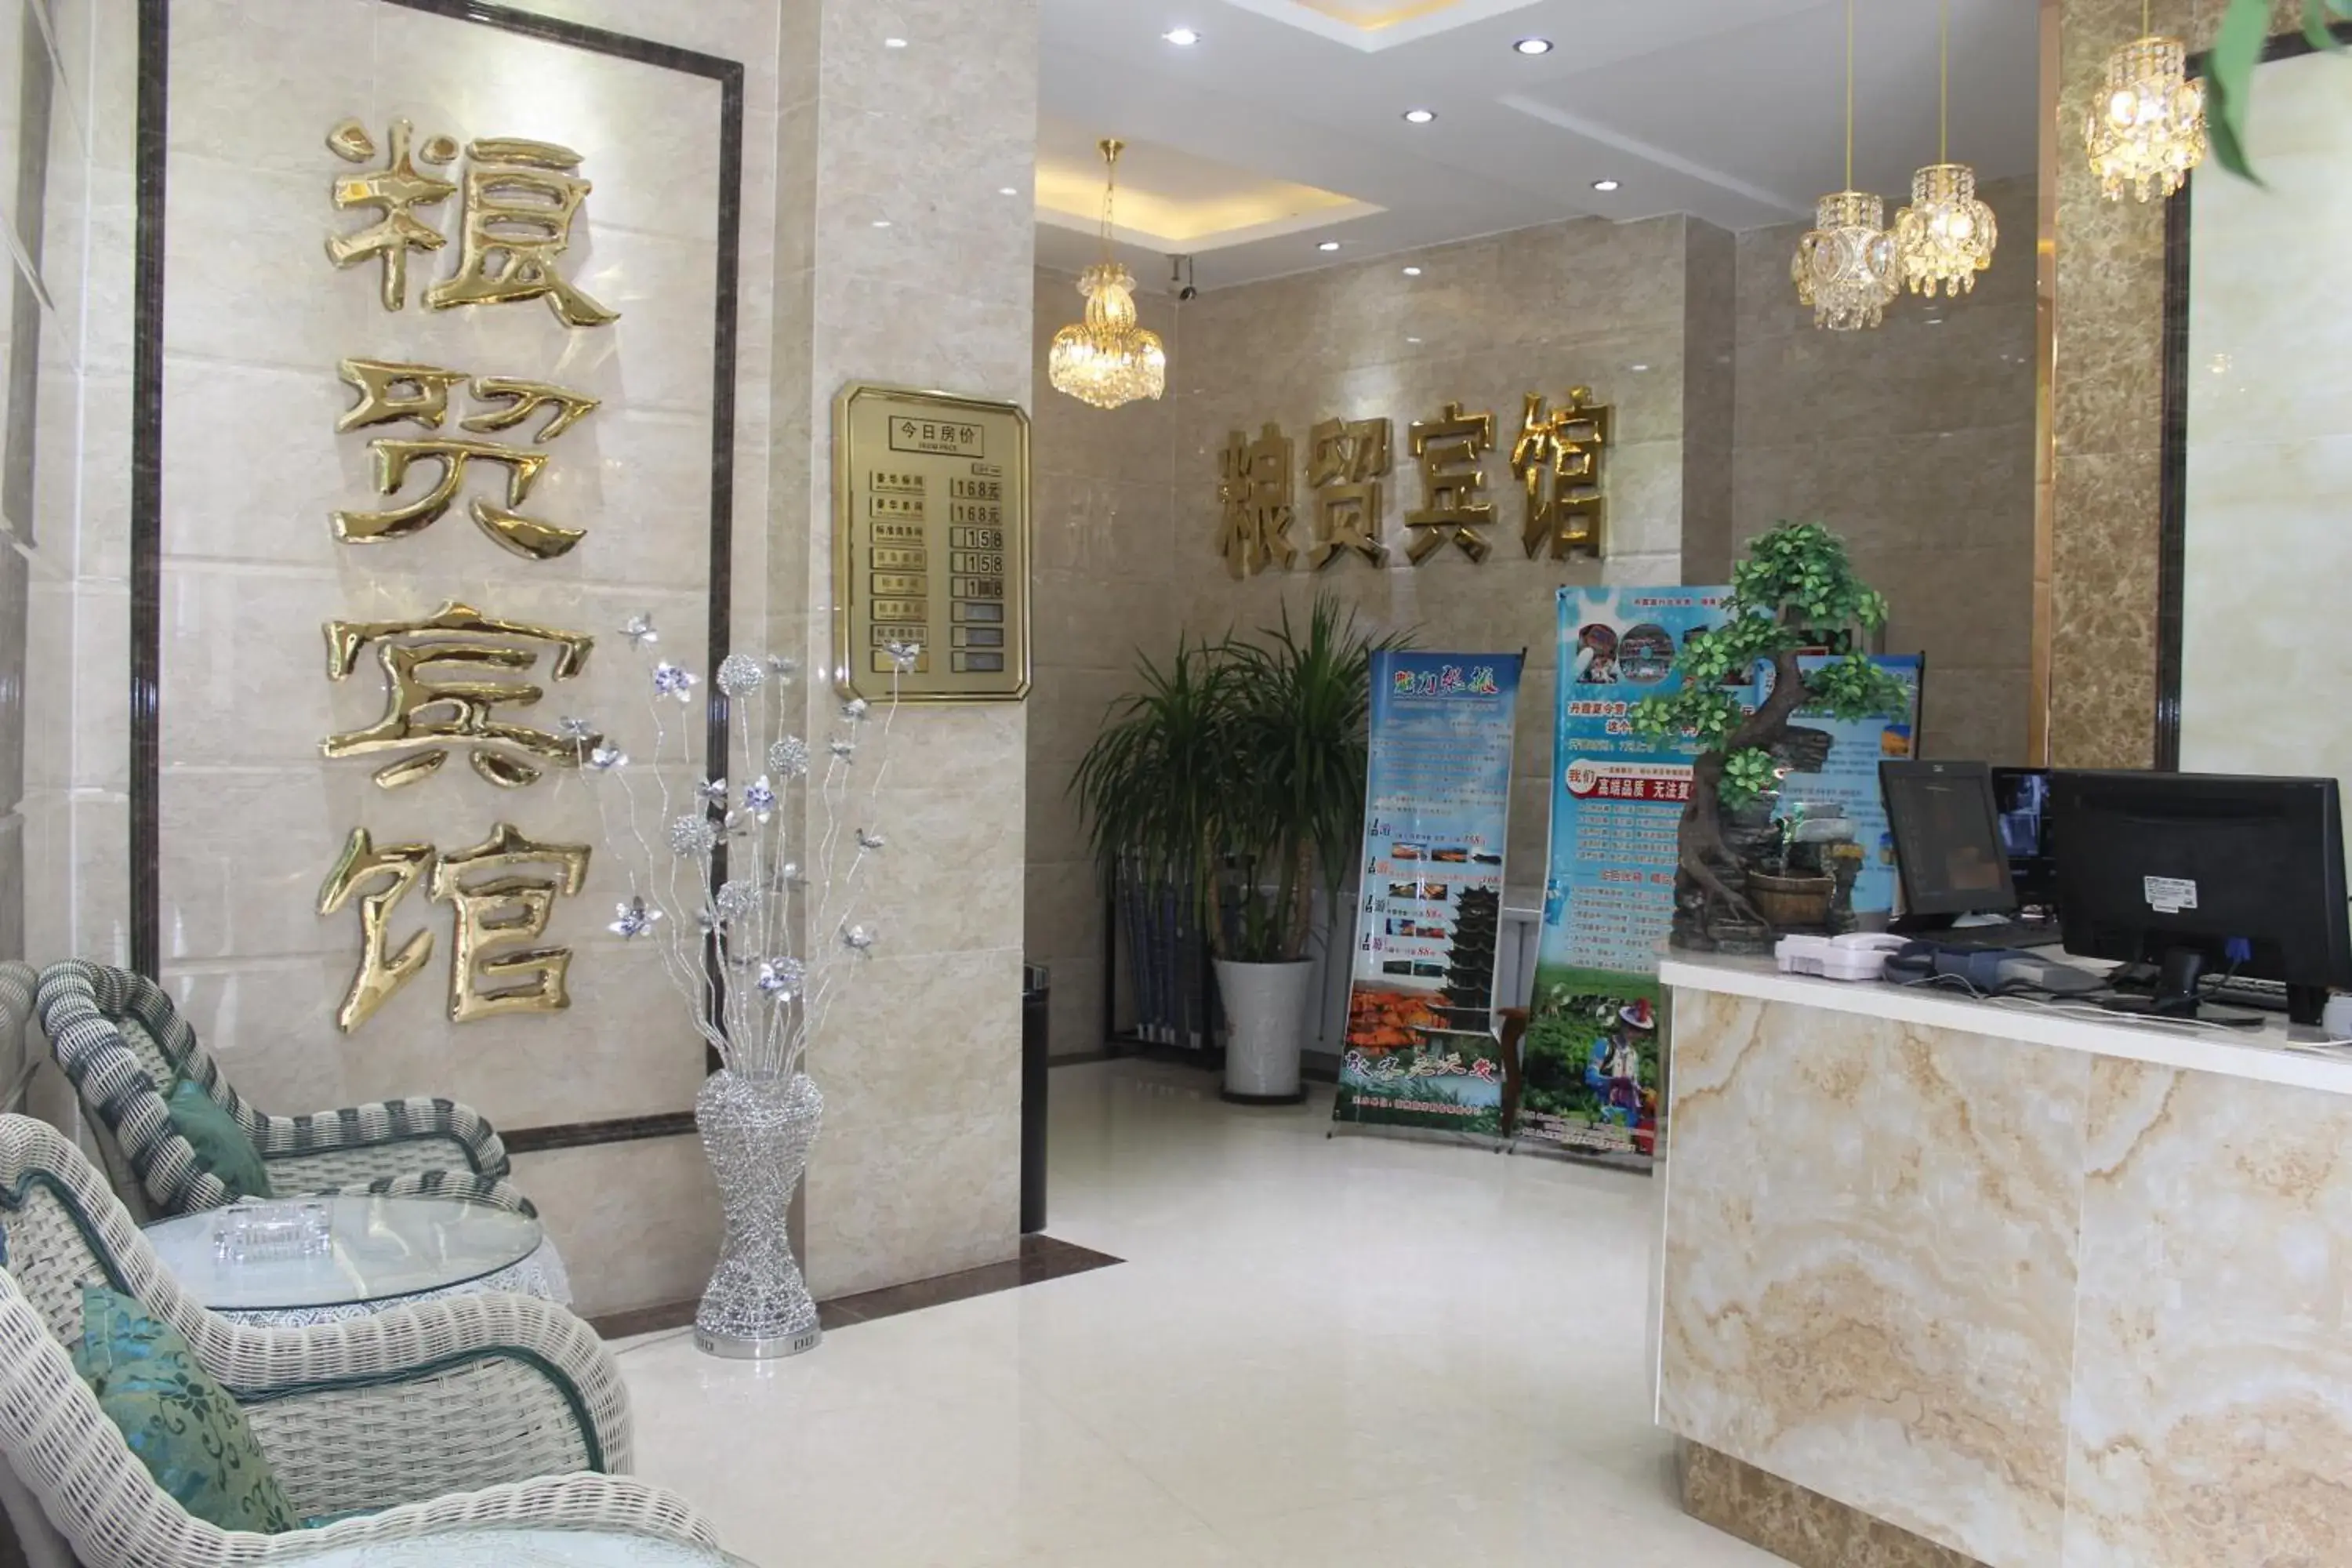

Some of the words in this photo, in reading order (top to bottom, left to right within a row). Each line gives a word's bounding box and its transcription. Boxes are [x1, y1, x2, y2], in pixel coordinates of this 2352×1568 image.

[902, 421, 975, 445] 今日房价
[957, 480, 1000, 499] 168元
[957, 506, 1000, 524] 168元
[969, 531, 1002, 547] 158
[969, 556, 1002, 572] 158
[318, 117, 620, 1034] 粮贸宾馆
